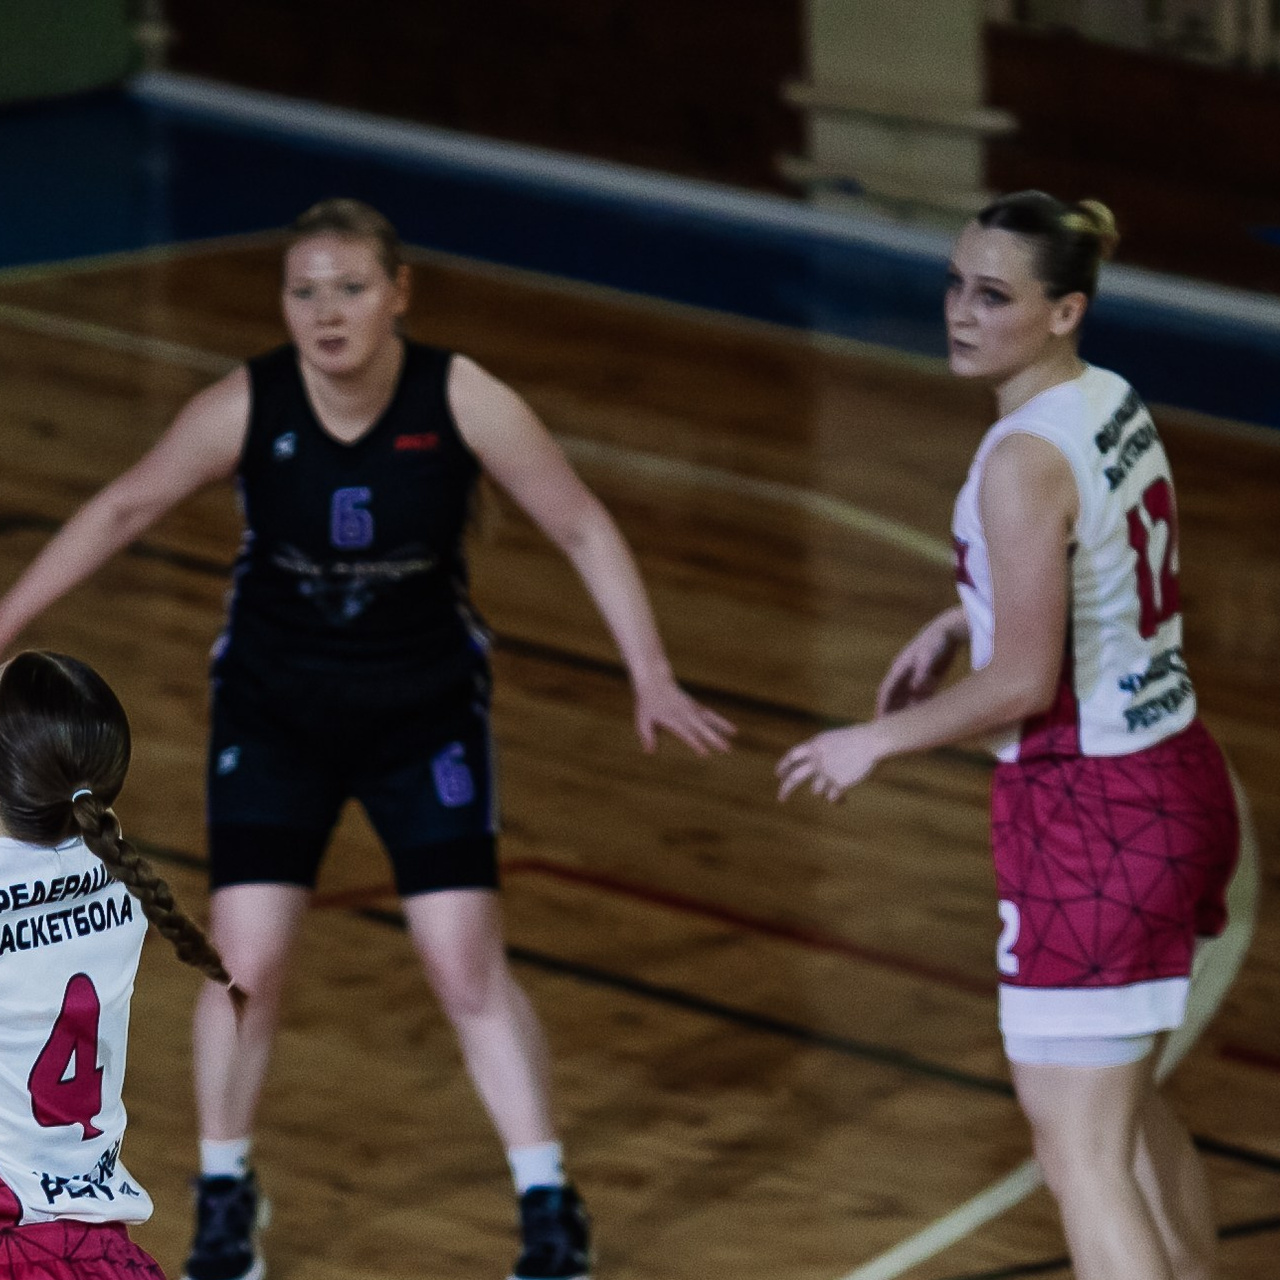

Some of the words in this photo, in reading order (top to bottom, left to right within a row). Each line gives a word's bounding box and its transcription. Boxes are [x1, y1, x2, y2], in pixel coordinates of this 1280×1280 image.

[330, 487, 375, 549] 6
[432, 742, 475, 806] 6
[28, 973, 104, 1142] 4
